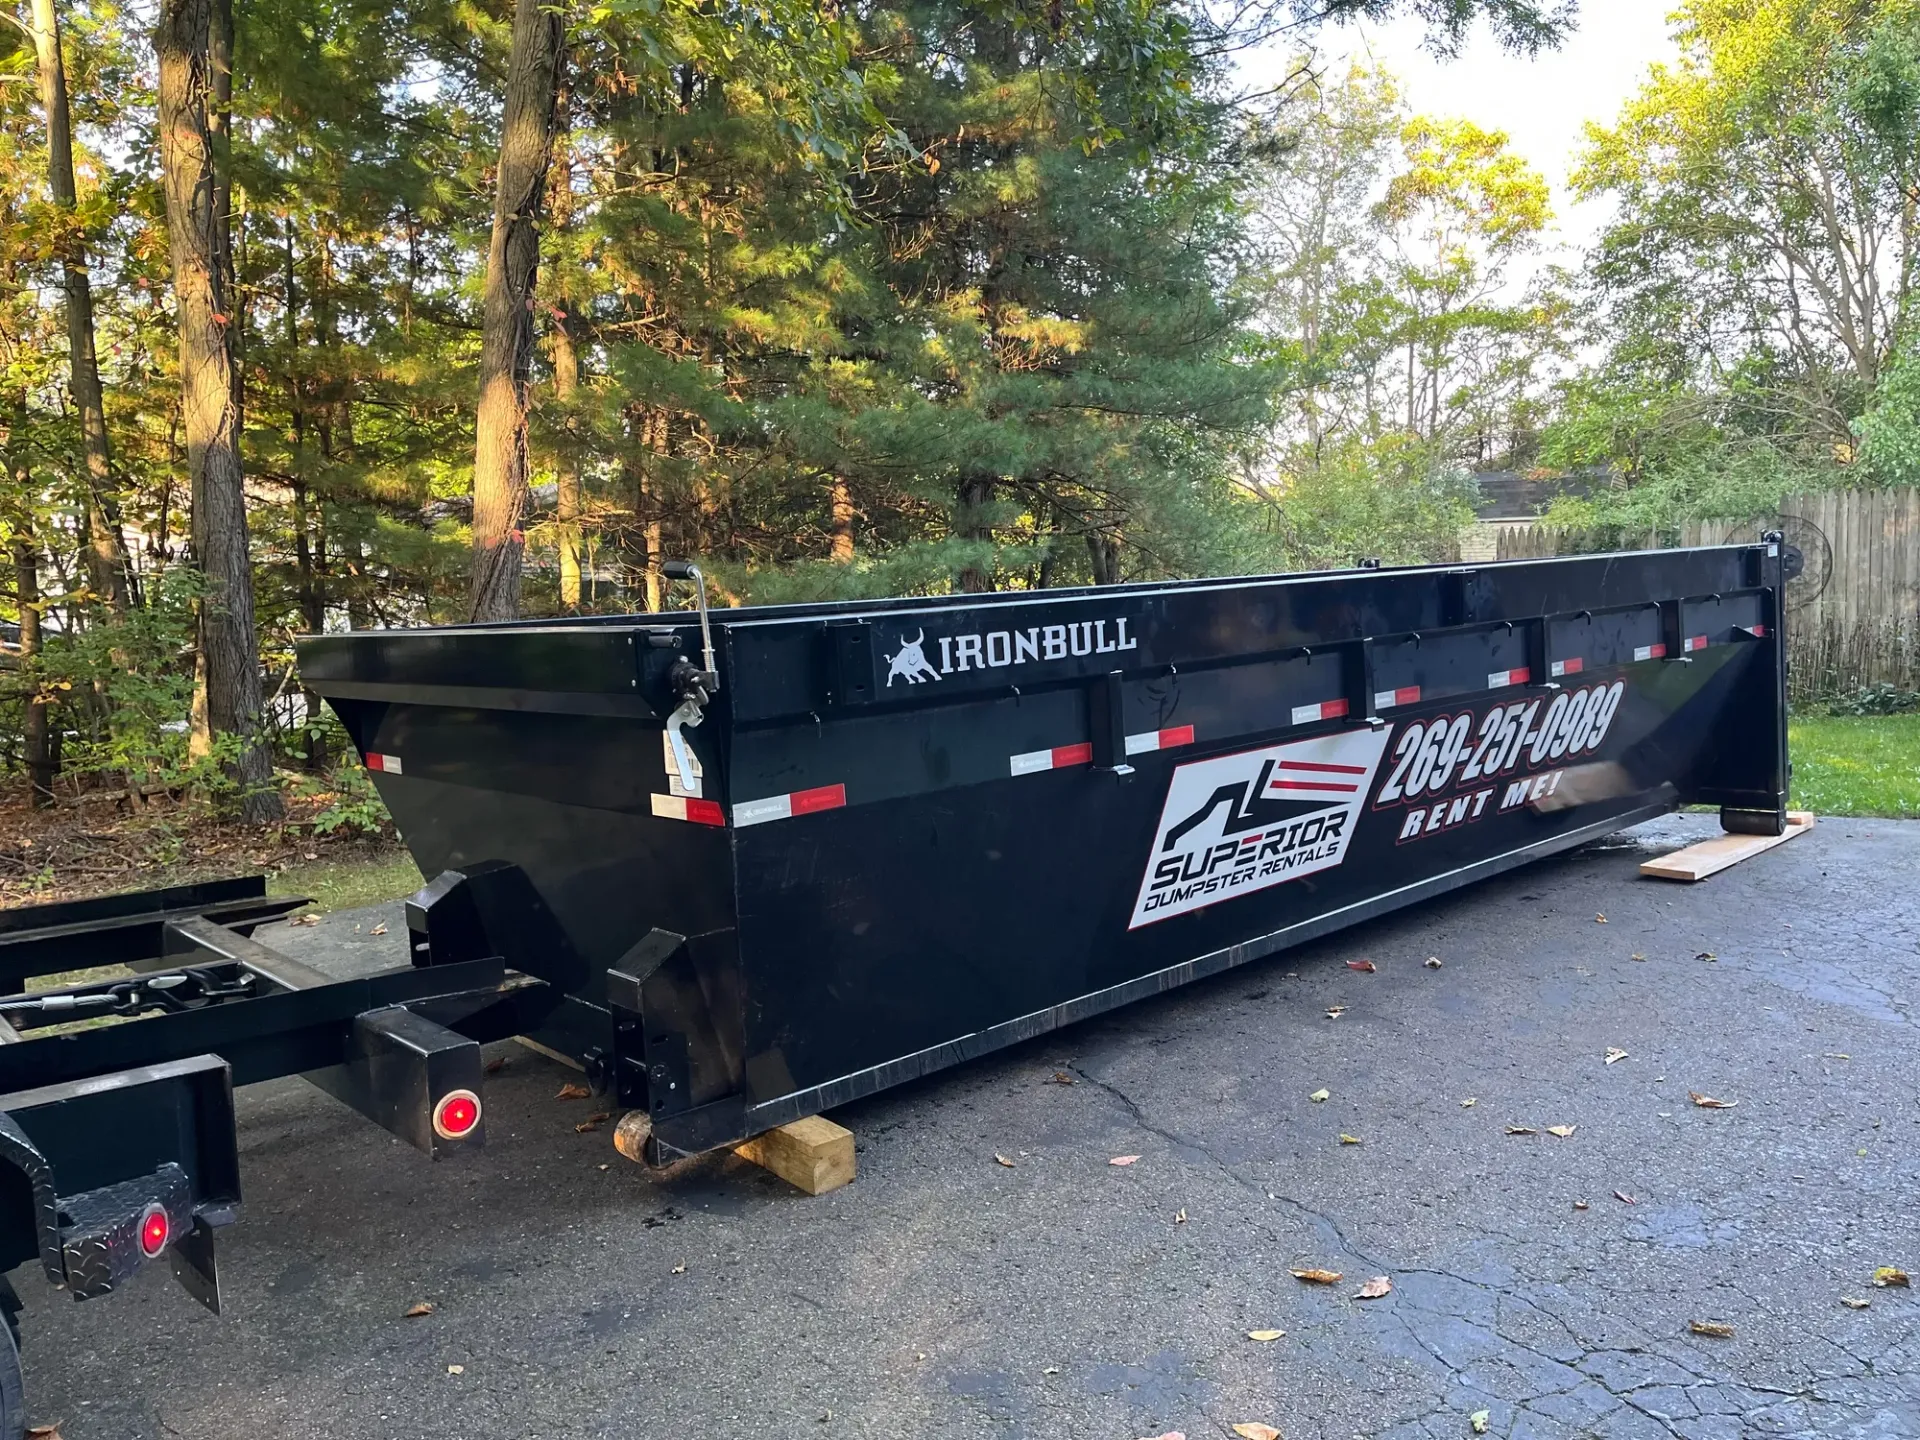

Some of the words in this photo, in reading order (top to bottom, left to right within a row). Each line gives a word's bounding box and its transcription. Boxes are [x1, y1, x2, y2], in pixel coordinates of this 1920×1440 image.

[939, 617, 1138, 674] IRONBULL
[1375, 679, 1626, 805] 269-251-0989
[1398, 788, 1494, 841] RENT
[1500, 770, 1564, 810] ME!
[1143, 866, 1257, 912] DUMPSTER
[1259, 841, 1341, 878] RENTALS
[1150, 810, 1349, 892] SUPERIOR
